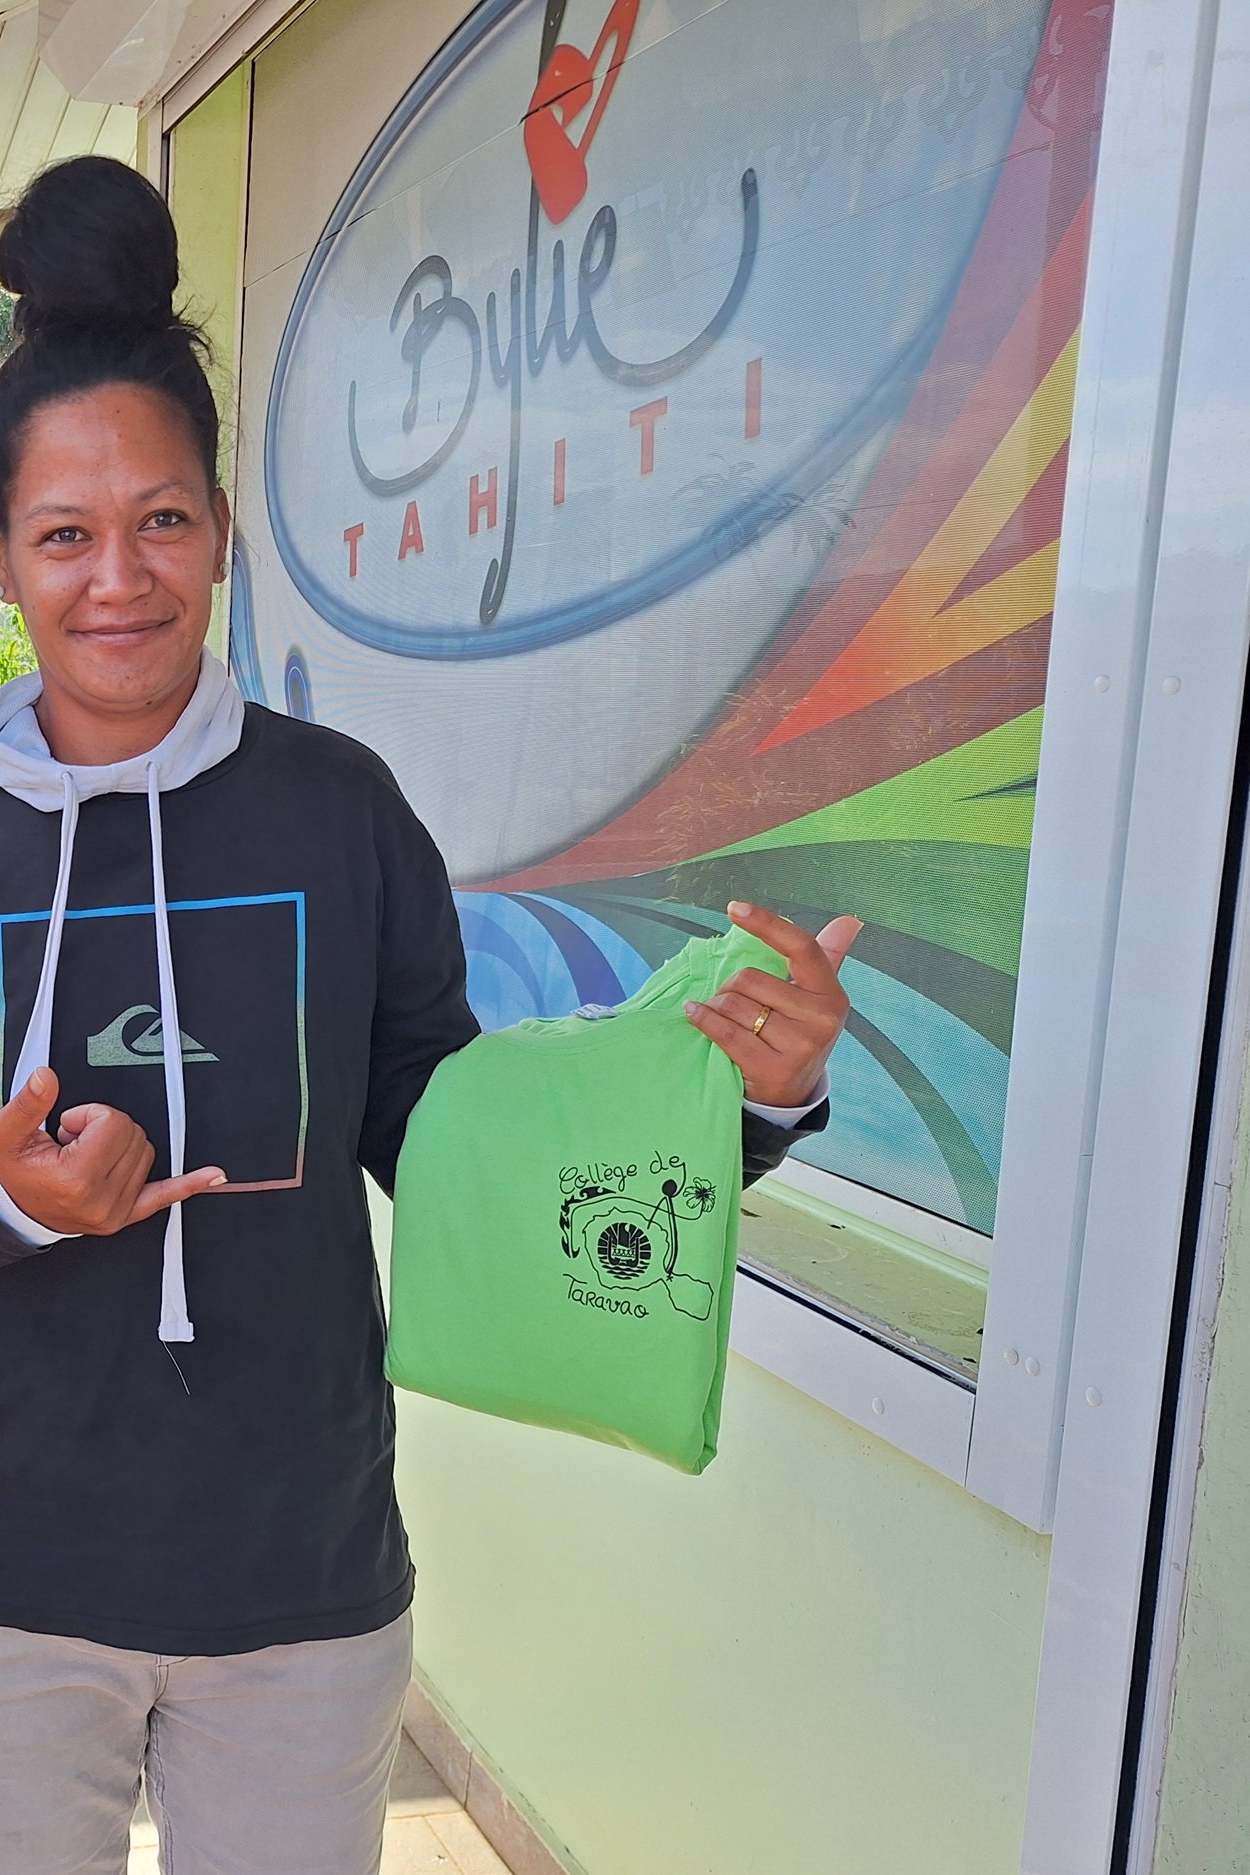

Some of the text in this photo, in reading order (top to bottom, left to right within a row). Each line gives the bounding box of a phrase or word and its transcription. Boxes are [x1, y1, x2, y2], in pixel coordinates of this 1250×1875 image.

[343, 357, 763, 577] TAHITI
[559, 1150, 684, 1195] Collège de
